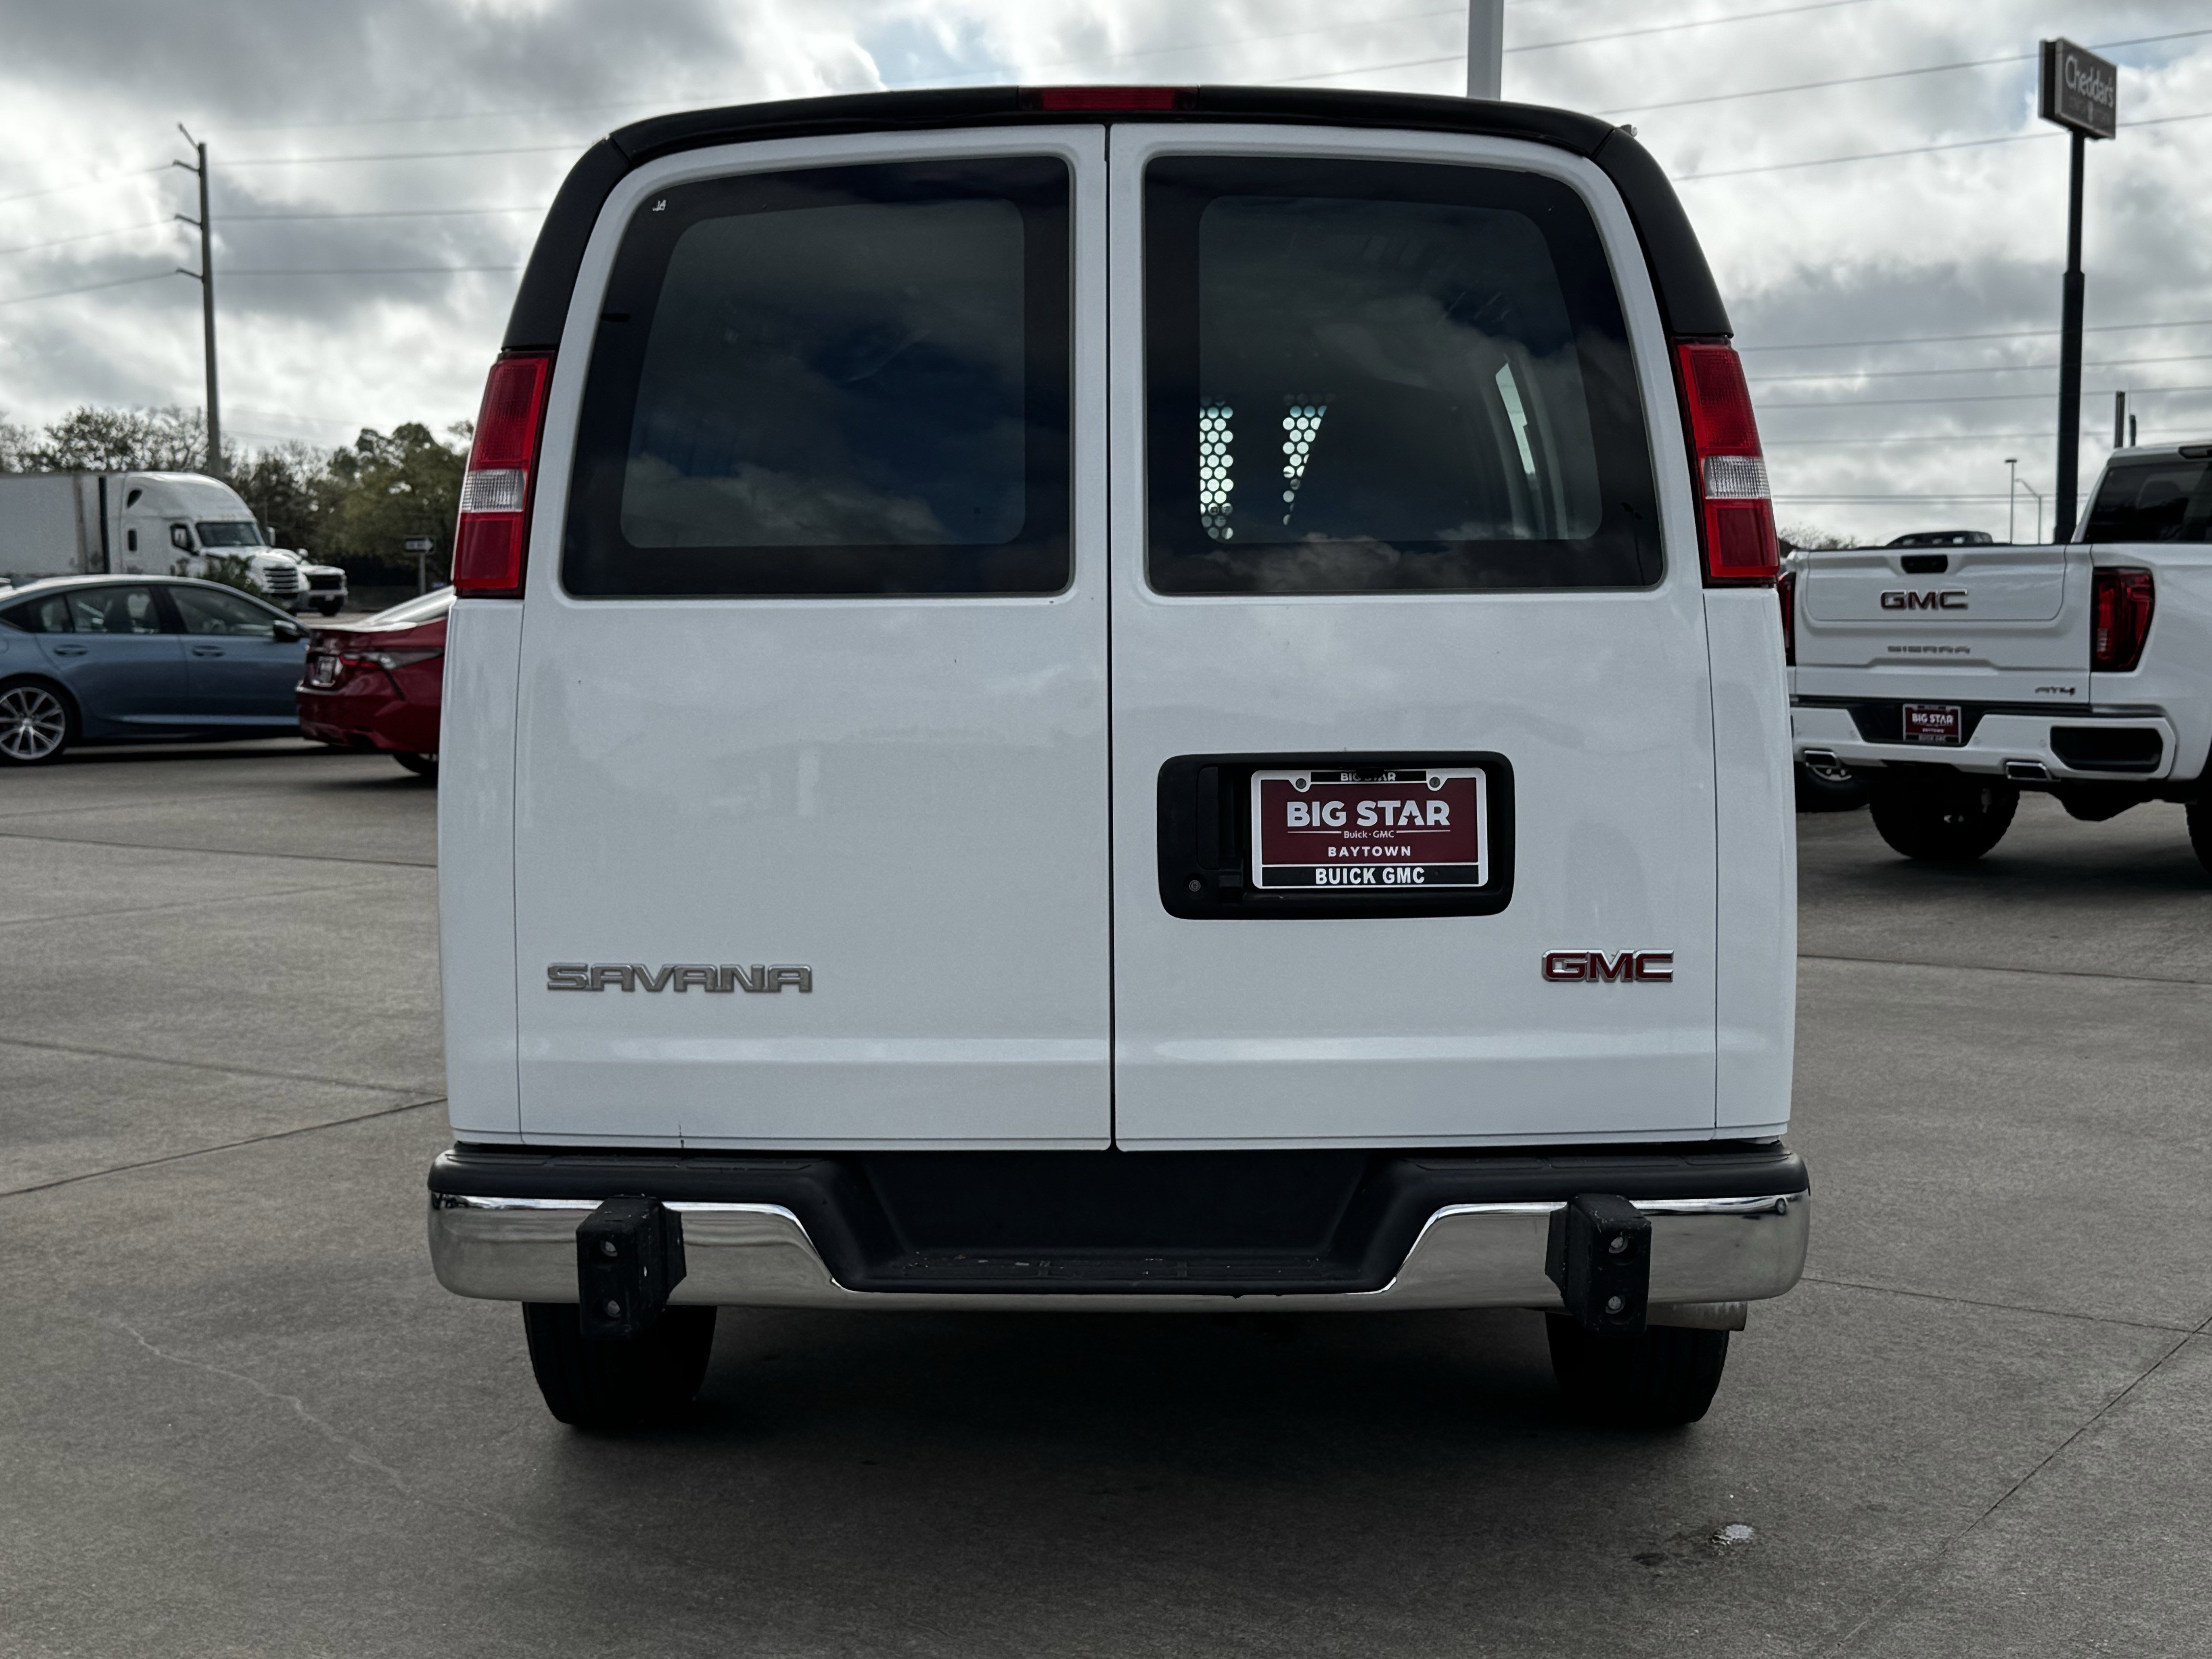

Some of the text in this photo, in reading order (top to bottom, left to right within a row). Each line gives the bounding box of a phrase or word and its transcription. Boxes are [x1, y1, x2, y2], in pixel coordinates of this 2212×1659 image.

[1881, 589, 1968, 610] GMC
[1912, 713, 1954, 725] BIG STAR
[1364, 772, 1396, 781] AR
[1287, 800, 1451, 827] BIG STAR
[1328, 846, 1411, 857] BAYTOWN
[1316, 867, 1425, 884] BUICK GMC
[1541, 949, 1674, 982] GMC
[547, 963, 812, 993] SAVANA
